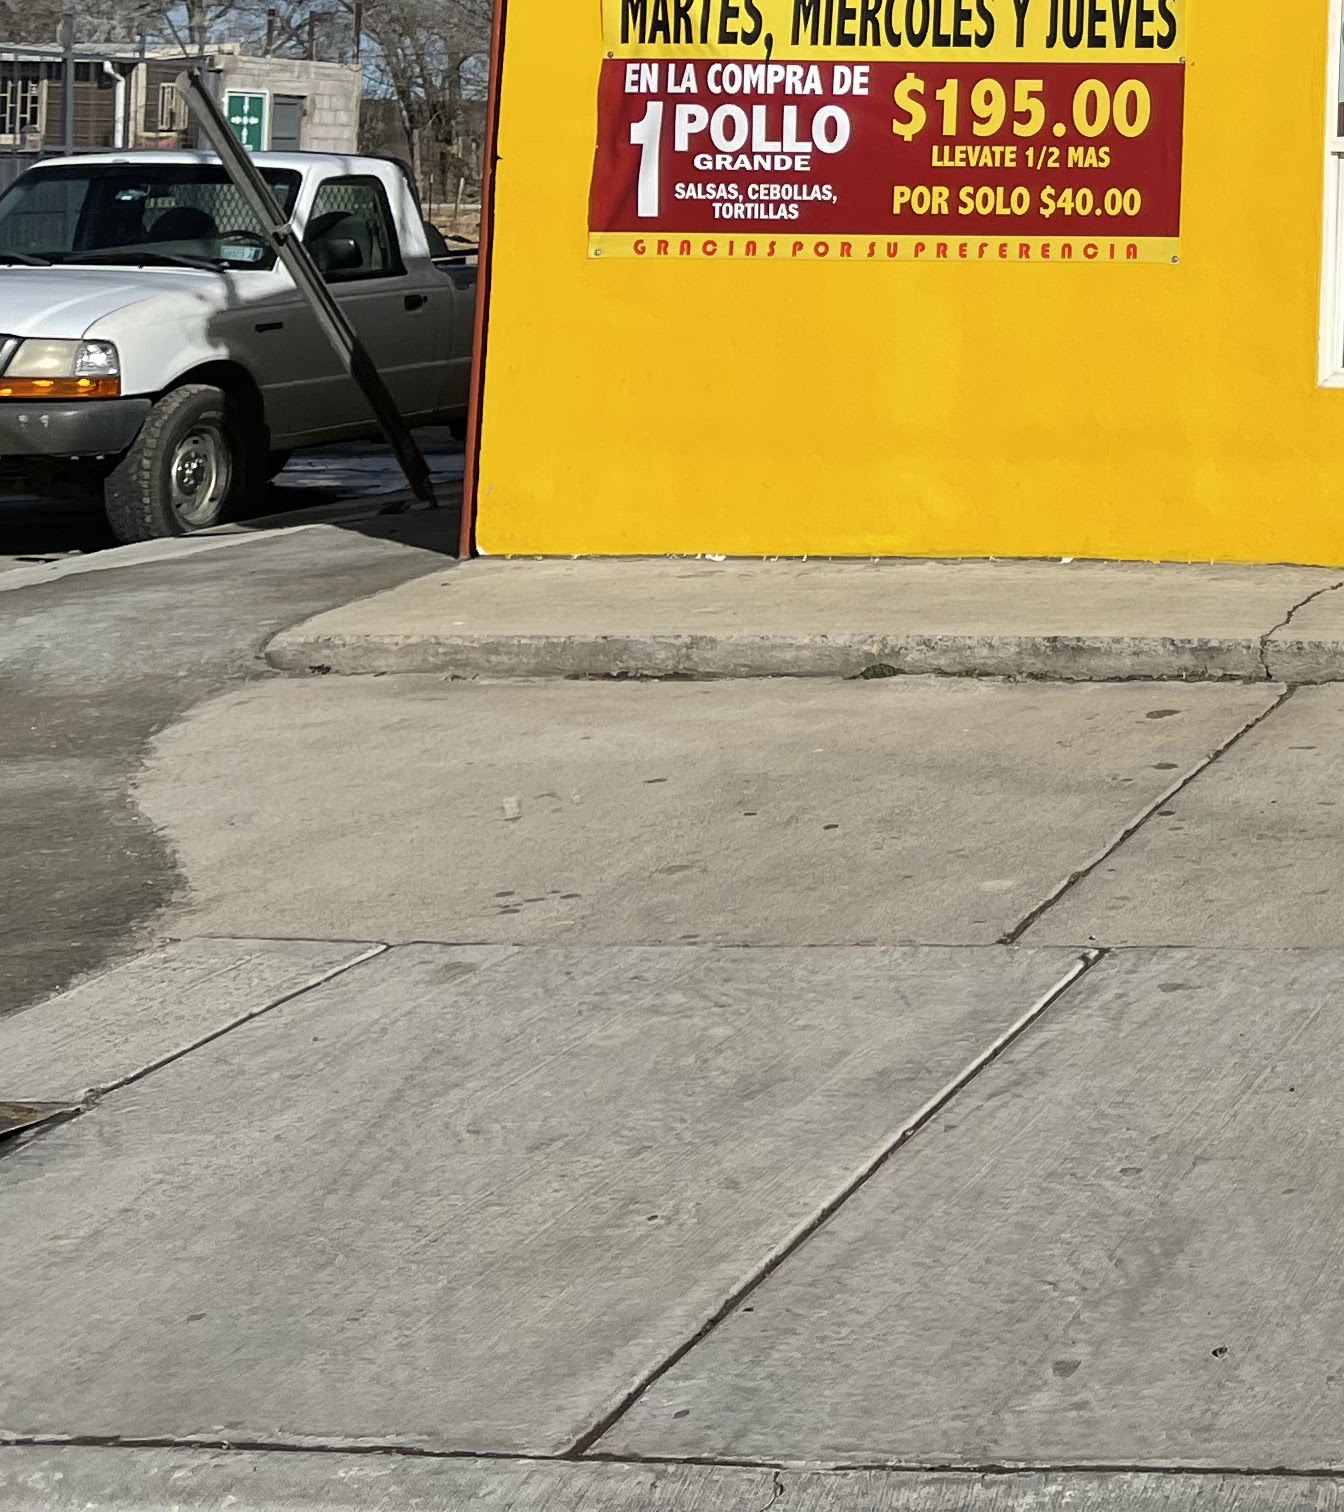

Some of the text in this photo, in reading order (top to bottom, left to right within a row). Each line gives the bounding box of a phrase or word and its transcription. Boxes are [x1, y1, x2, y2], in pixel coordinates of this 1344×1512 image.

[625, 63, 869, 95] EN LA COMPRA DE
[893, 73, 1150, 141] $195.00
[630, 101, 850, 217] 1 POLLO
[694, 154, 811, 171] GRANDE
[932, 145, 1110, 170] LLEVATE 1/2 MAS
[675, 183, 837, 204] SALSAS, CEBOLLAS,
[893, 185, 1141, 218] POR SOLO $40.00
[712, 203, 798, 219] TORTILLAS
[634, 240, 1137, 259] GRACIAS POR SU PREFERENCIA
